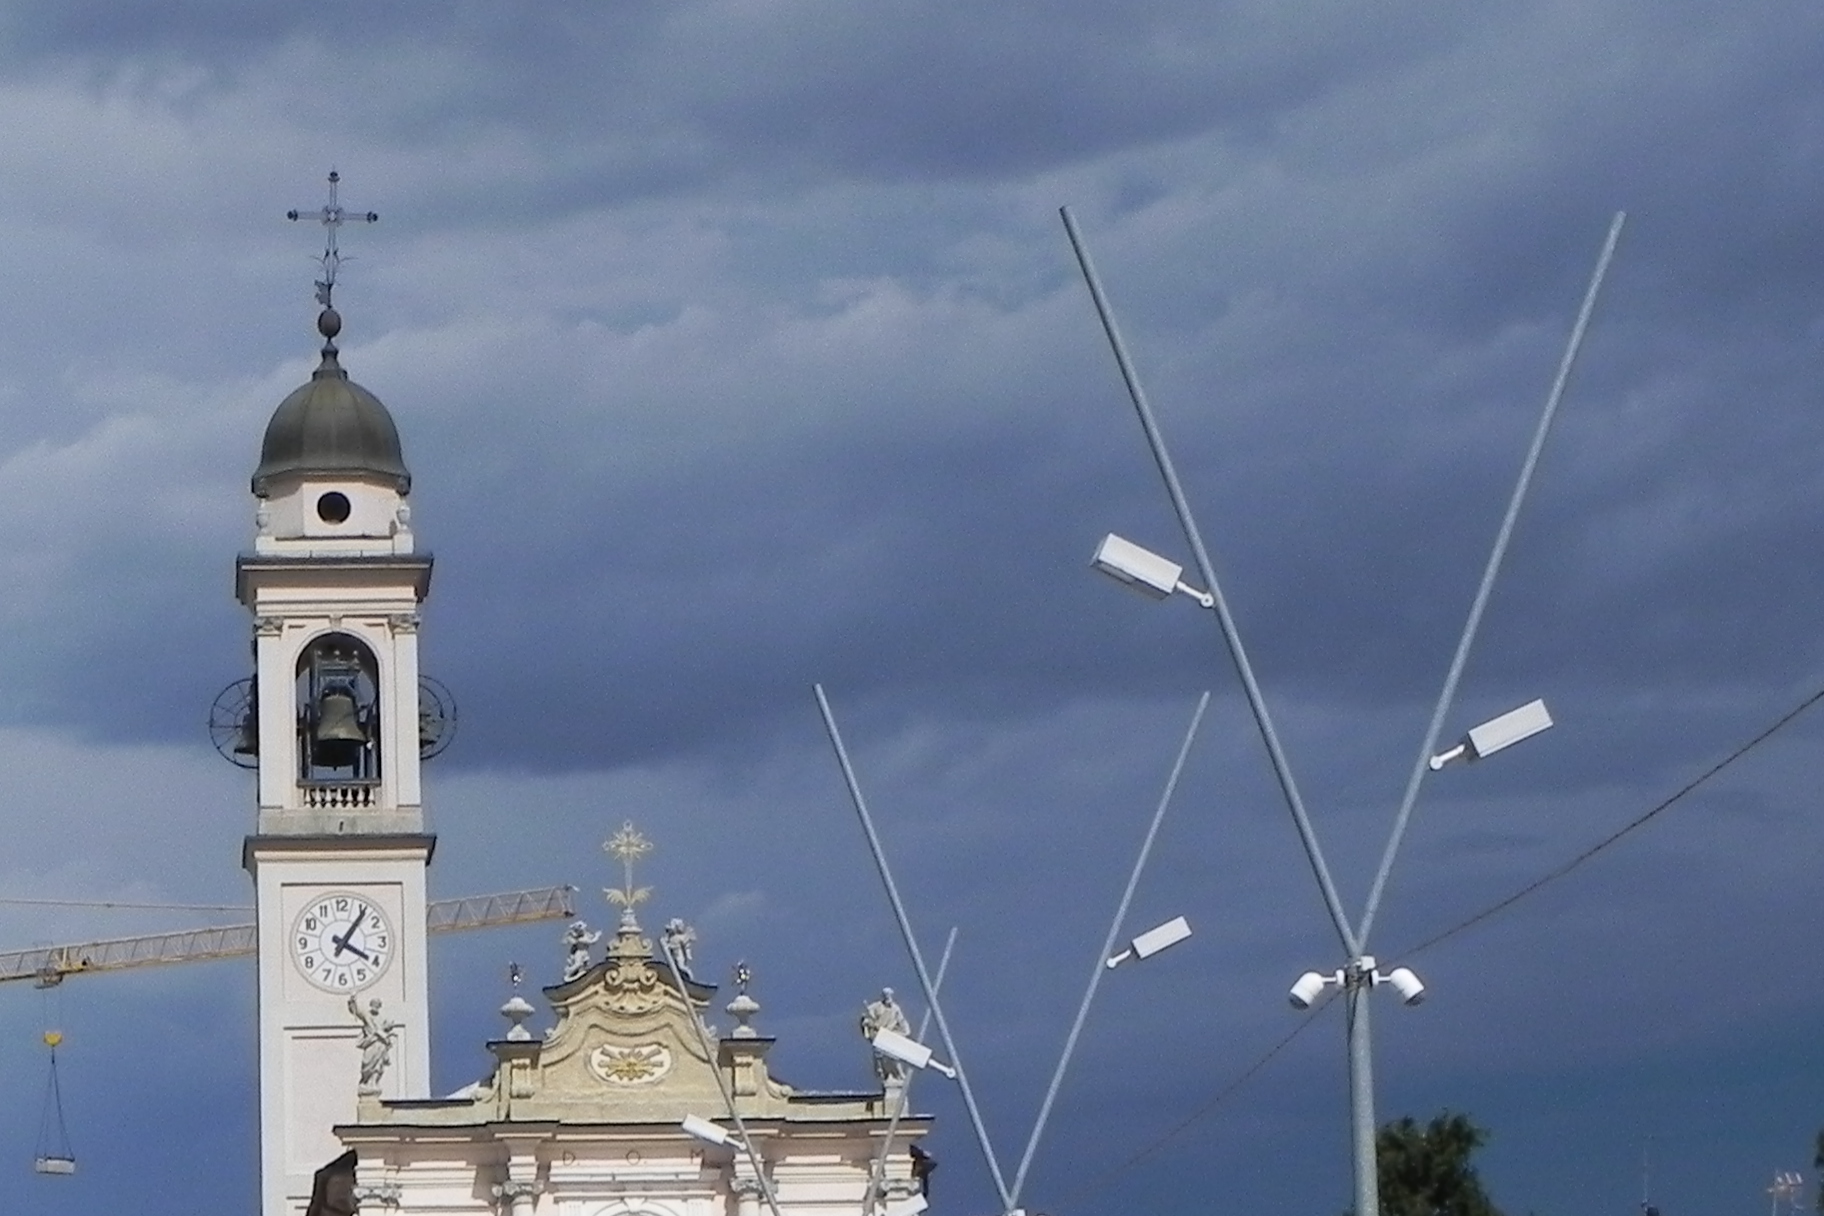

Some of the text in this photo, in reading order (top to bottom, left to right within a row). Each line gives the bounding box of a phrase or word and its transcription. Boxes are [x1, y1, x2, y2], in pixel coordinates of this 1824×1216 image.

[319, 904, 328, 918] 11
[335, 899, 349, 912] 12
[305, 917, 317, 931] 10
[370, 915, 380, 929] 2
[298, 936, 308, 950] 9
[377, 935, 387, 949] 3
[304, 955, 314, 969] 8
[322, 968, 332, 982] 7
[338, 973, 348, 986] 6
[356, 968, 366, 982] 5
